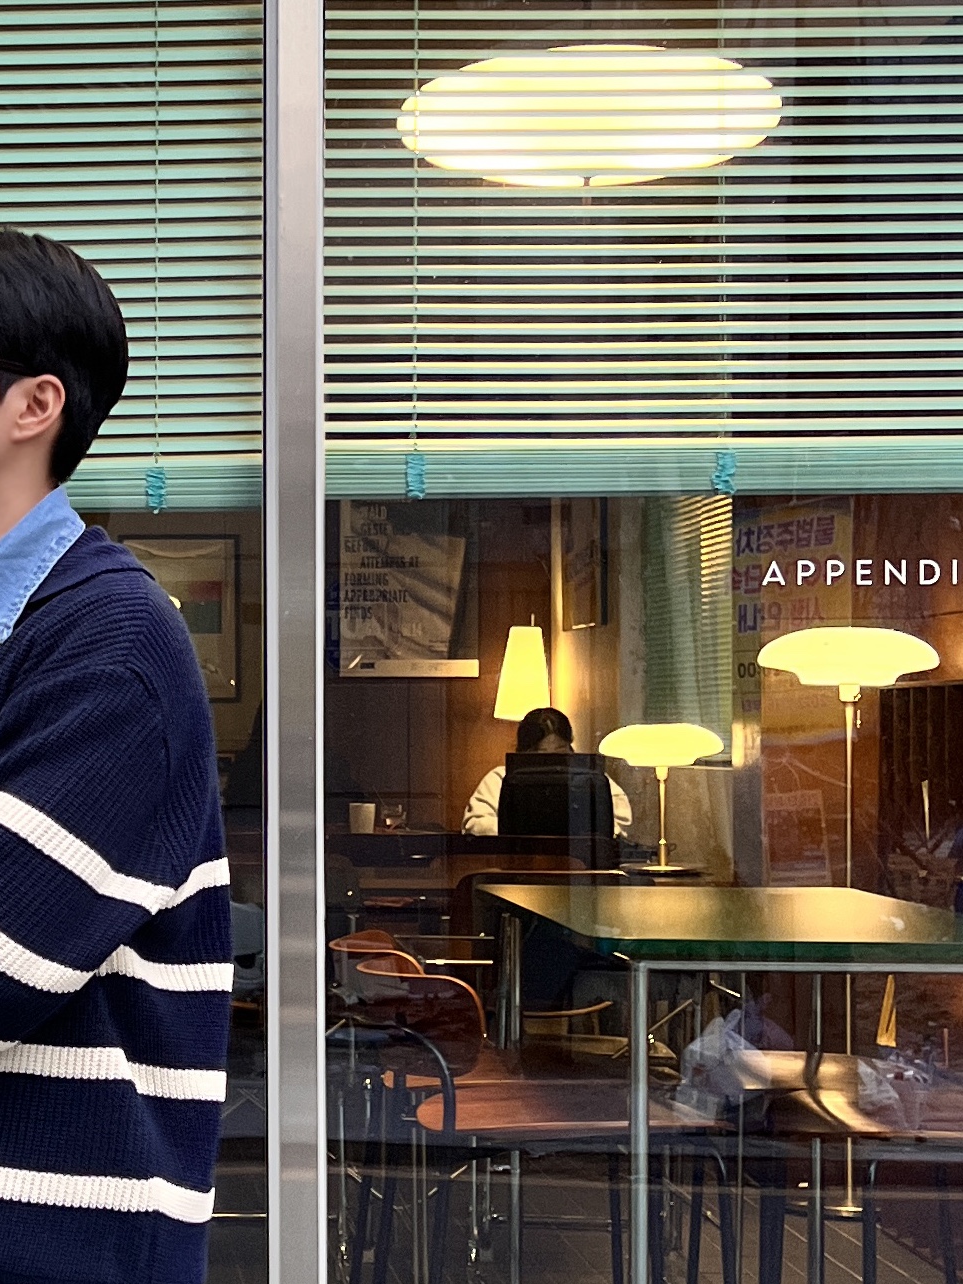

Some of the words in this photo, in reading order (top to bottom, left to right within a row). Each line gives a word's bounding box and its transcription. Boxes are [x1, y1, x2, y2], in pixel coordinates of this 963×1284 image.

[409, 556, 420, 569] AT
[344, 572, 389, 586] FORMING
[343, 589, 409, 603] APPROPRIATE
